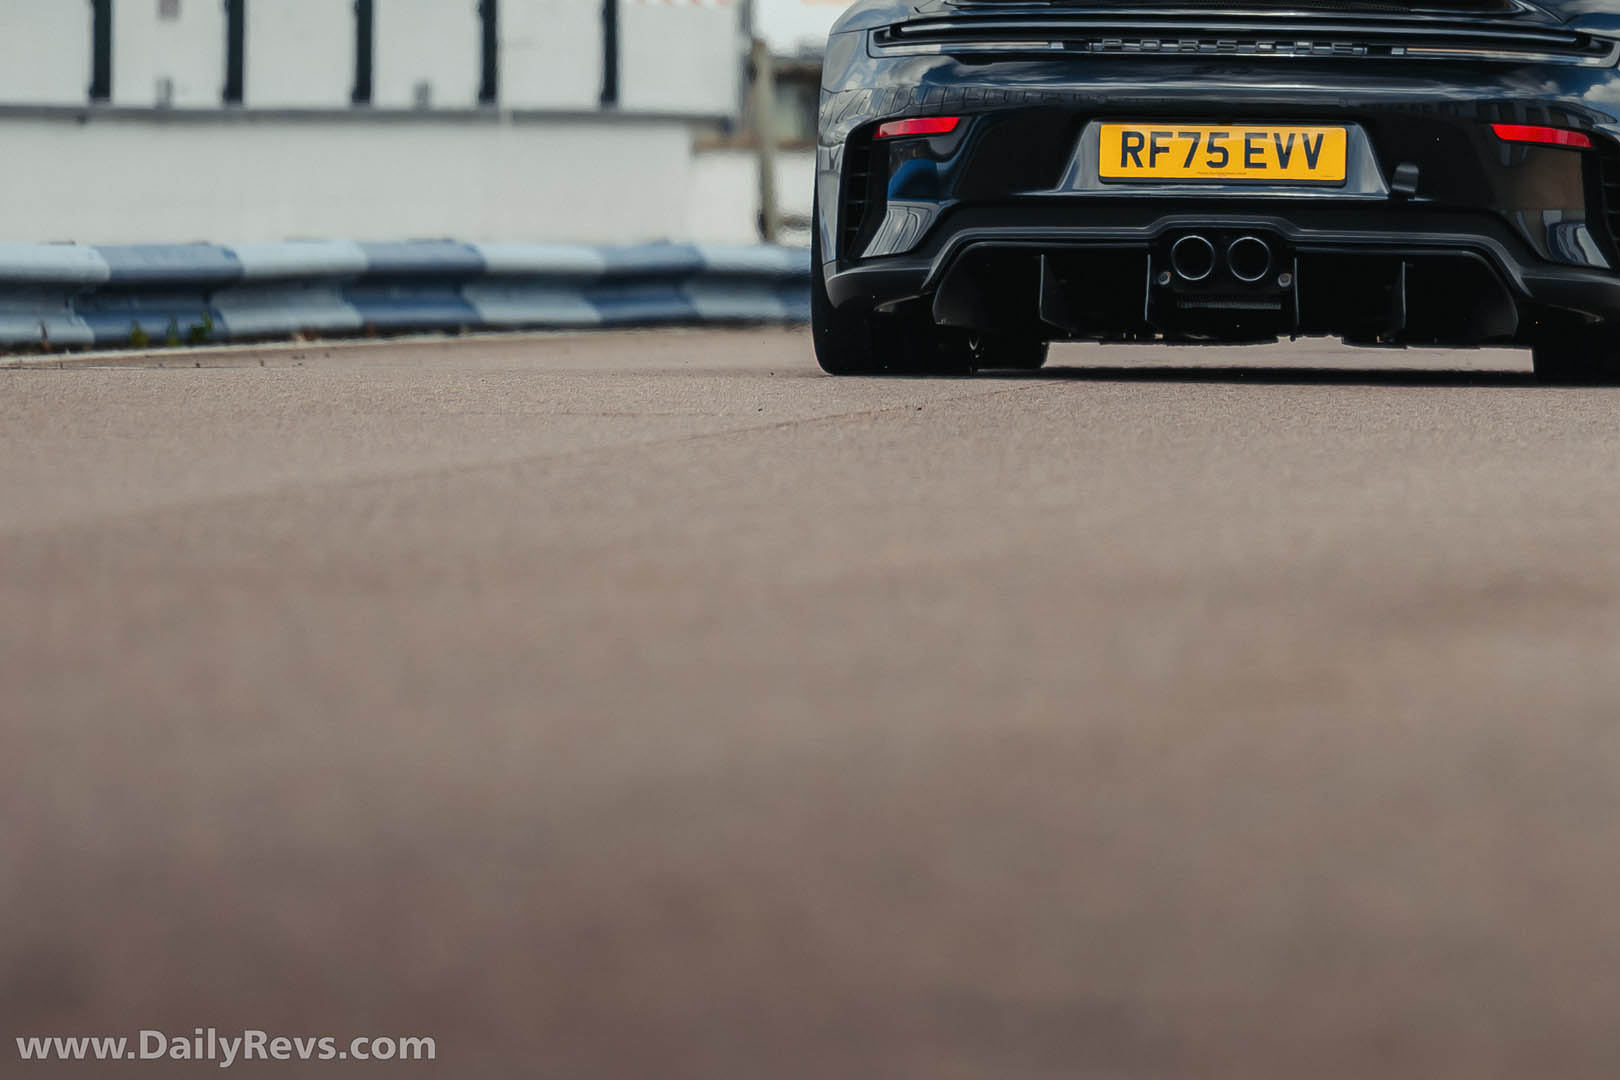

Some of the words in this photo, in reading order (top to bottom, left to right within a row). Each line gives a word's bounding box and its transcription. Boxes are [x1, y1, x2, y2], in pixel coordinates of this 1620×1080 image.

[1101, 38, 1354, 54] PORSCHE
[1119, 130, 1230, 169] RF75
[1243, 131, 1325, 170] EVV
